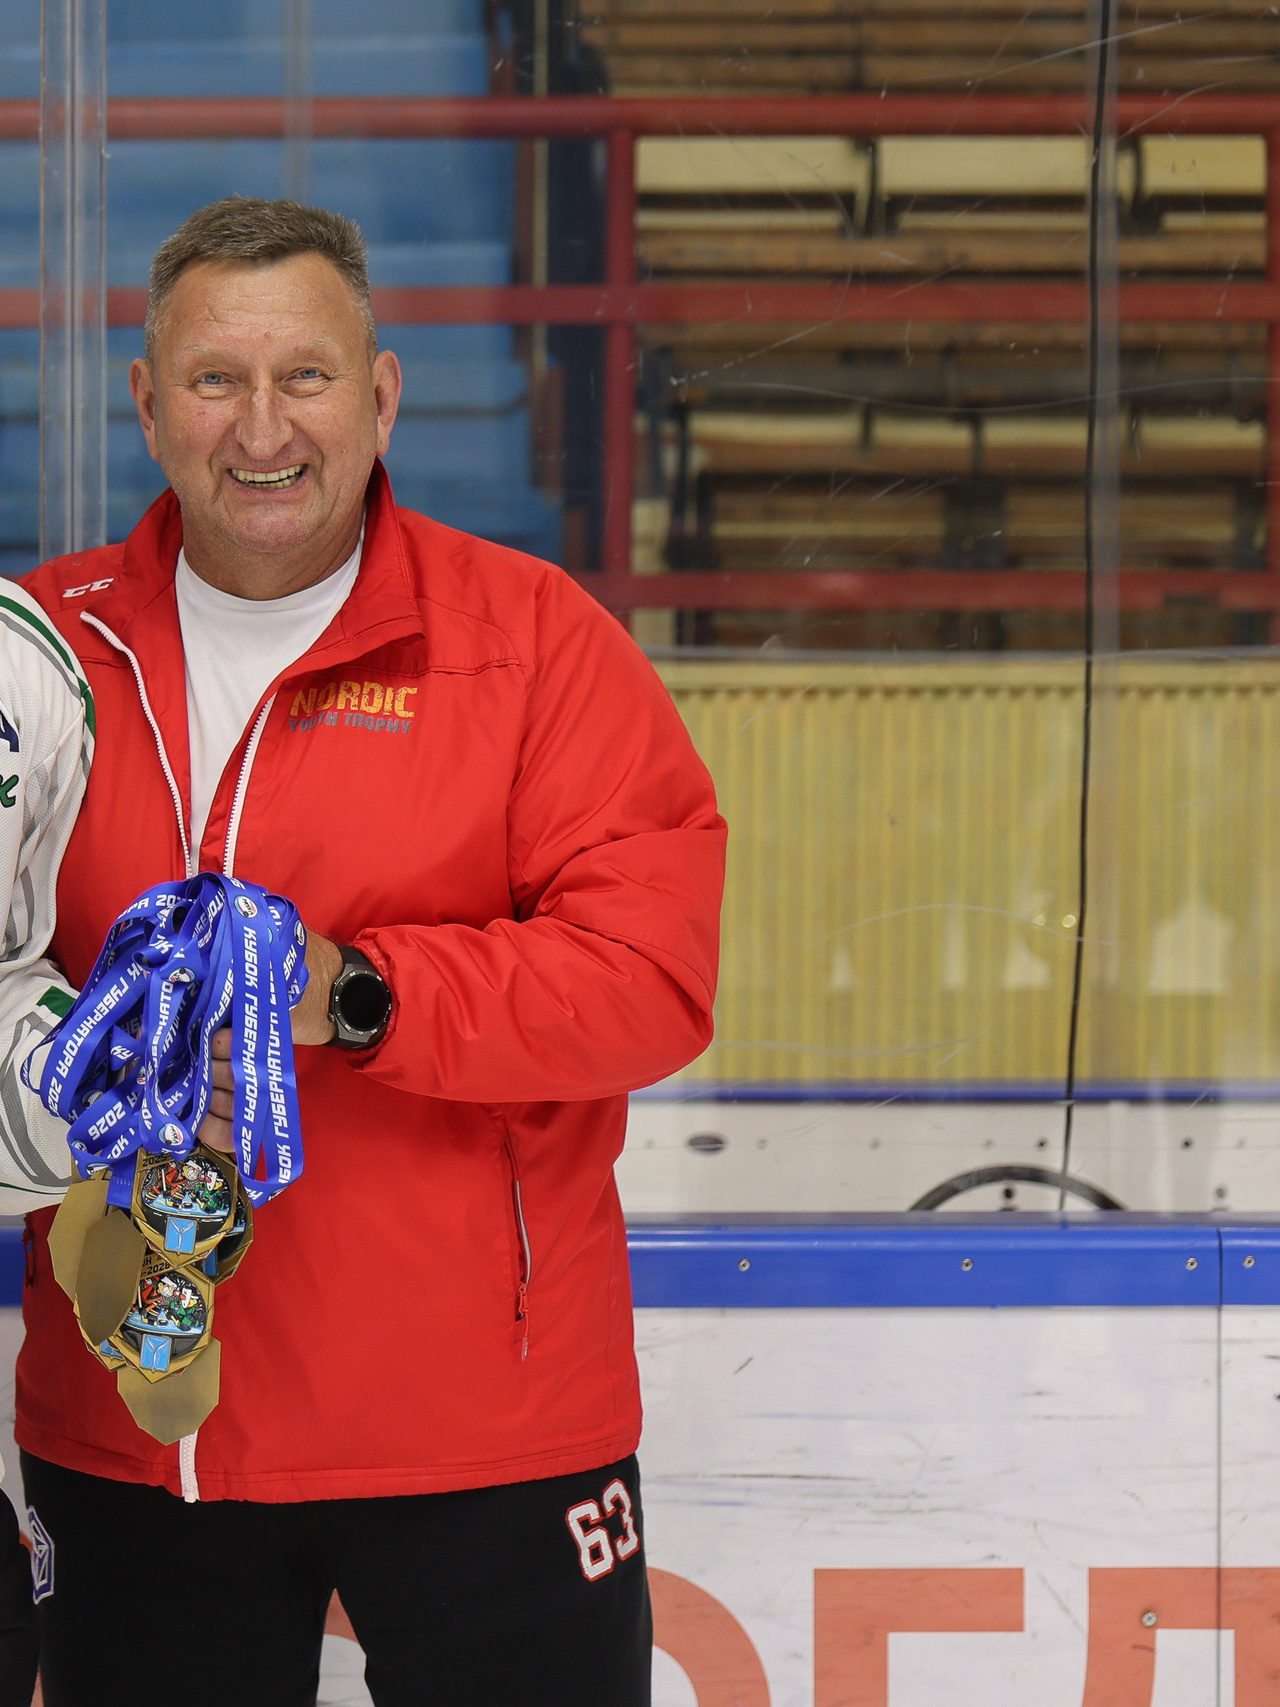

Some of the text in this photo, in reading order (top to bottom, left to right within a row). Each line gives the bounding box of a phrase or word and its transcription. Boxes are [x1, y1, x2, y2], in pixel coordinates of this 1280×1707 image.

[288, 711, 413, 734] YOUTH TROPHY
[289, 680, 418, 718] NORDIC
[55, 976, 130, 1078] ГУБЕРНАТОРА
[202, 968, 234, 1083] БЕРНАТОРА
[241, 926, 260, 1176] КУБОК ГУБЕРНАТОРА 2026
[87, 1101, 127, 1141] 2026
[191, 1085, 208, 1135] 2026
[278, 1142, 293, 1184] БОК
[565, 1478, 640, 1582] 63
